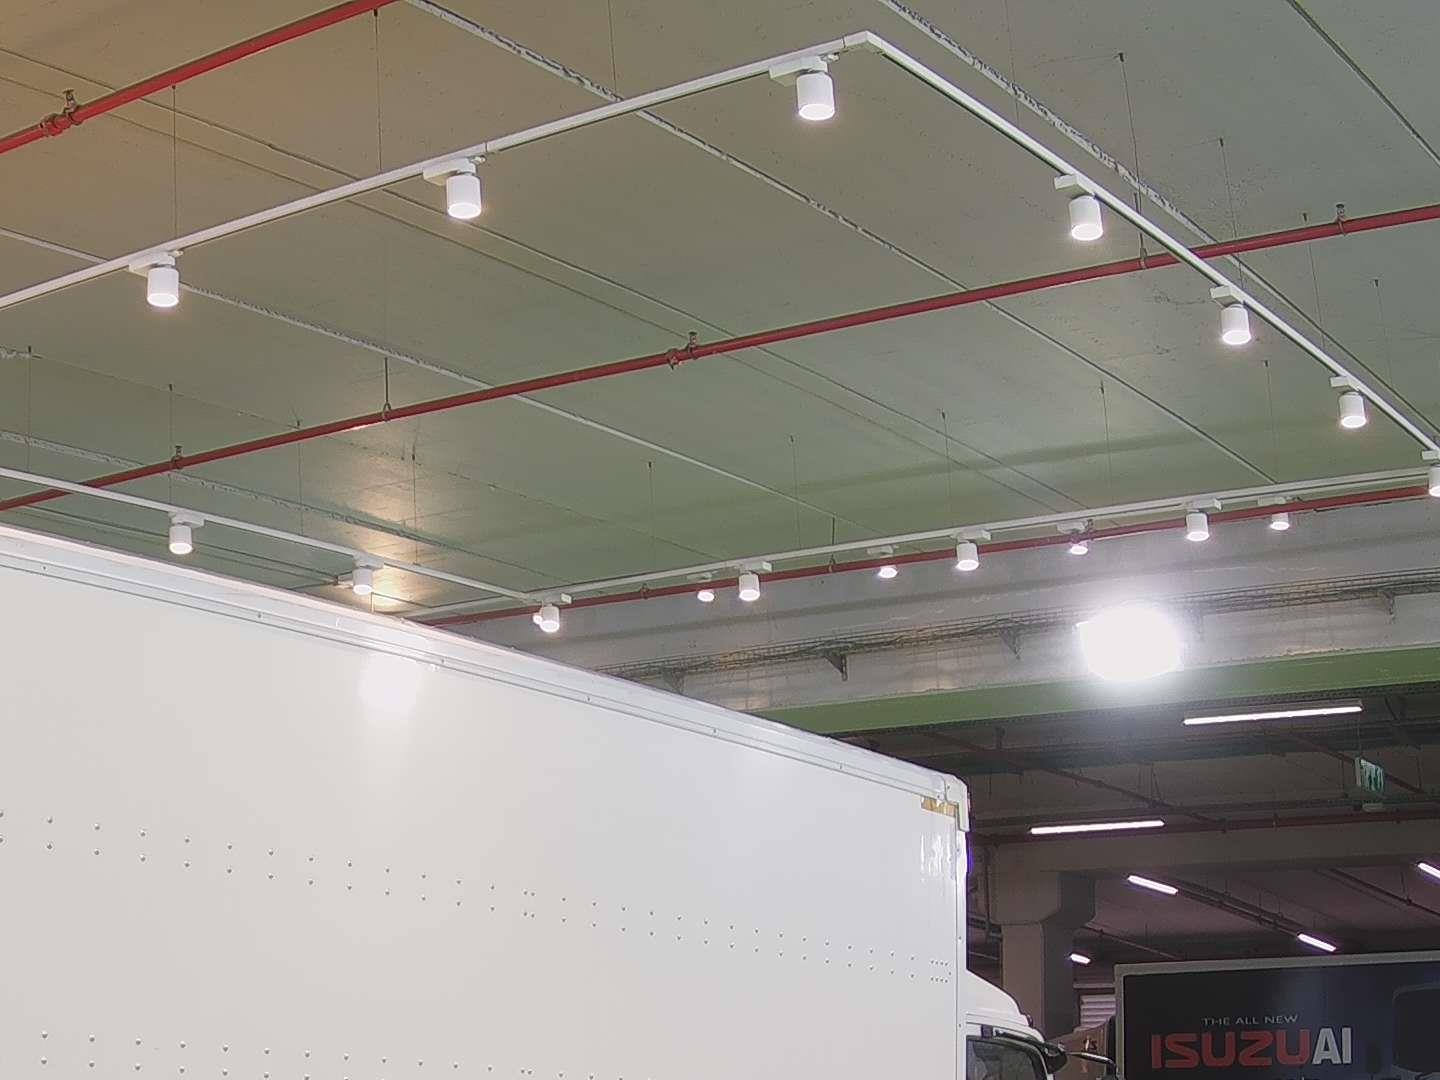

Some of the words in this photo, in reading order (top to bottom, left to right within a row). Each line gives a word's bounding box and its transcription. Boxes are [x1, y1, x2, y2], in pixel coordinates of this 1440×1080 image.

[1201, 1017, 1230, 1026] THE
[1235, 1015, 1259, 1025] ALL
[1265, 1014, 1298, 1024] NEW
